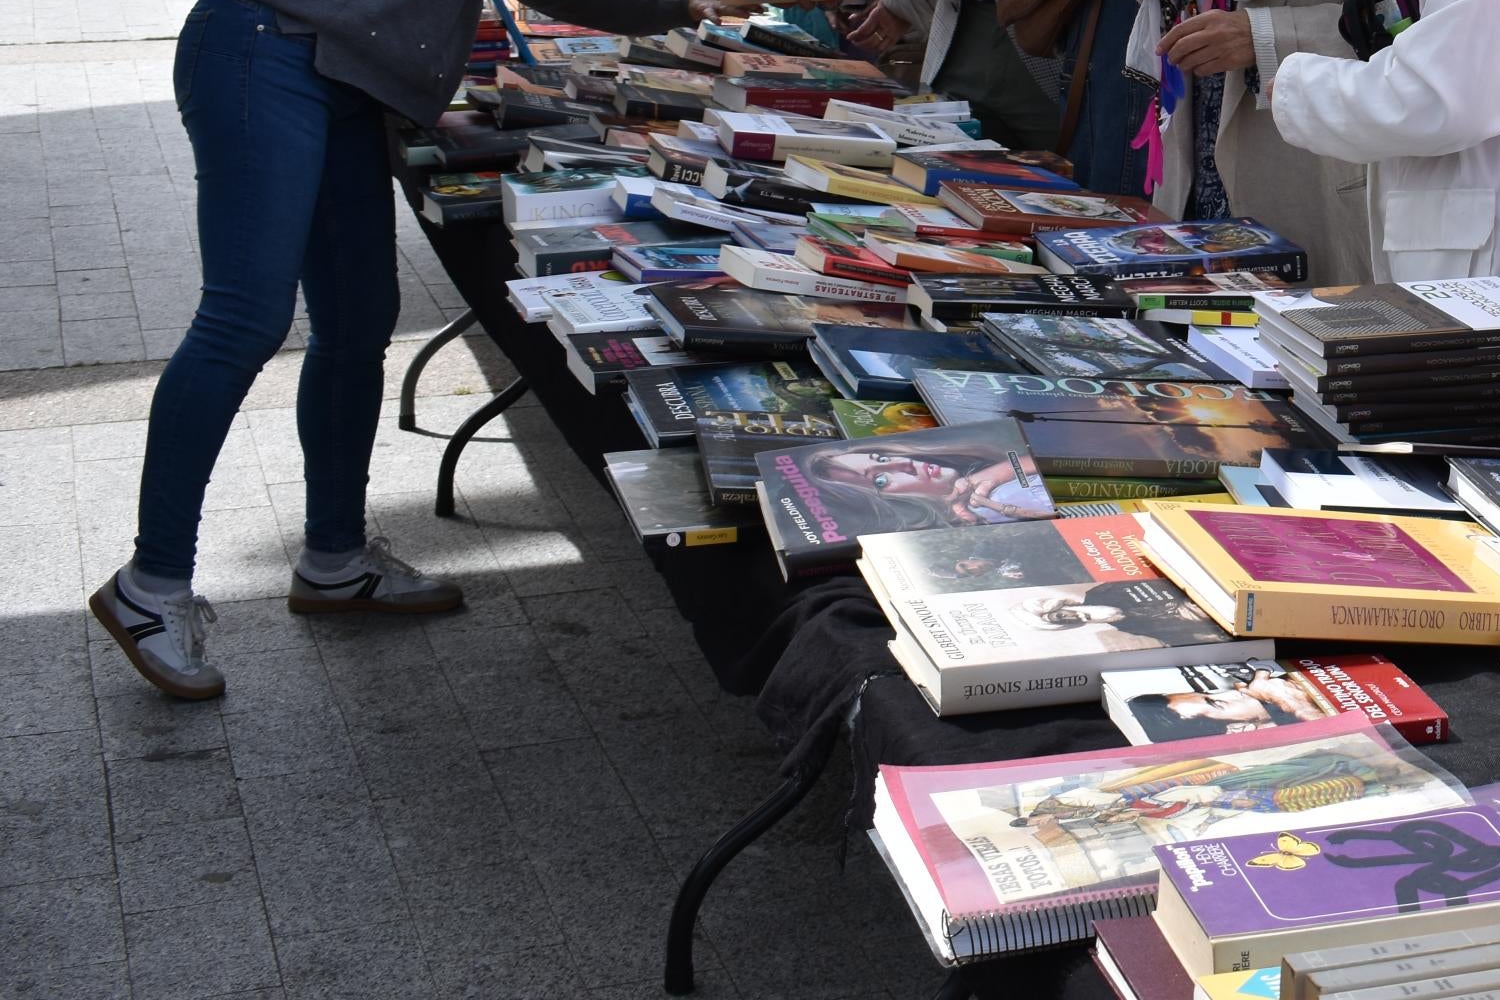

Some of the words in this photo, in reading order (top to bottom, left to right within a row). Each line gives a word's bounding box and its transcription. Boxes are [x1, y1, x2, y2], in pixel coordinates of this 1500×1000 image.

[814, 284, 882, 302] ESTRATEGIAS
[1041, 273, 1080, 303] MEGHAN
[1065, 273, 1105, 301] MARCH
[1025, 308, 1063, 316] MEGHAN
[1065, 309, 1098, 318] MARCH
[1168, 299, 1188, 307] KELBY
[775, 454, 848, 544] Perseguida
[780, 496, 809, 531] FIELDING
[803, 529, 822, 546] JOY
[1095, 530, 1114, 540] DE
[1080, 538, 1101, 557] Cercas
[1091, 555, 1118, 573] Javier
[1104, 540, 1142, 577] SOLDADOS
[907, 598, 940, 628] SINOUÉ
[1330, 605, 1401, 628] SALAMANCA
[1401, 608, 1417, 628] DE
[1418, 609, 1445, 629] ORO
[1458, 611, 1492, 632] LIBRO
[931, 627, 966, 661] GILBERT
[1299, 659, 1336, 686] TRABAJO
[1323, 664, 1353, 681] LUNA
[963, 678, 1027, 700] SINOUÉ
[1026, 674, 1088, 692] GILBERT
[1344, 680, 1375, 704] SEÑOR
[1327, 684, 1360, 712] ÚLTIMO
[1367, 703, 1388, 719] DEL
[1190, 845, 1214, 865] HENRI
